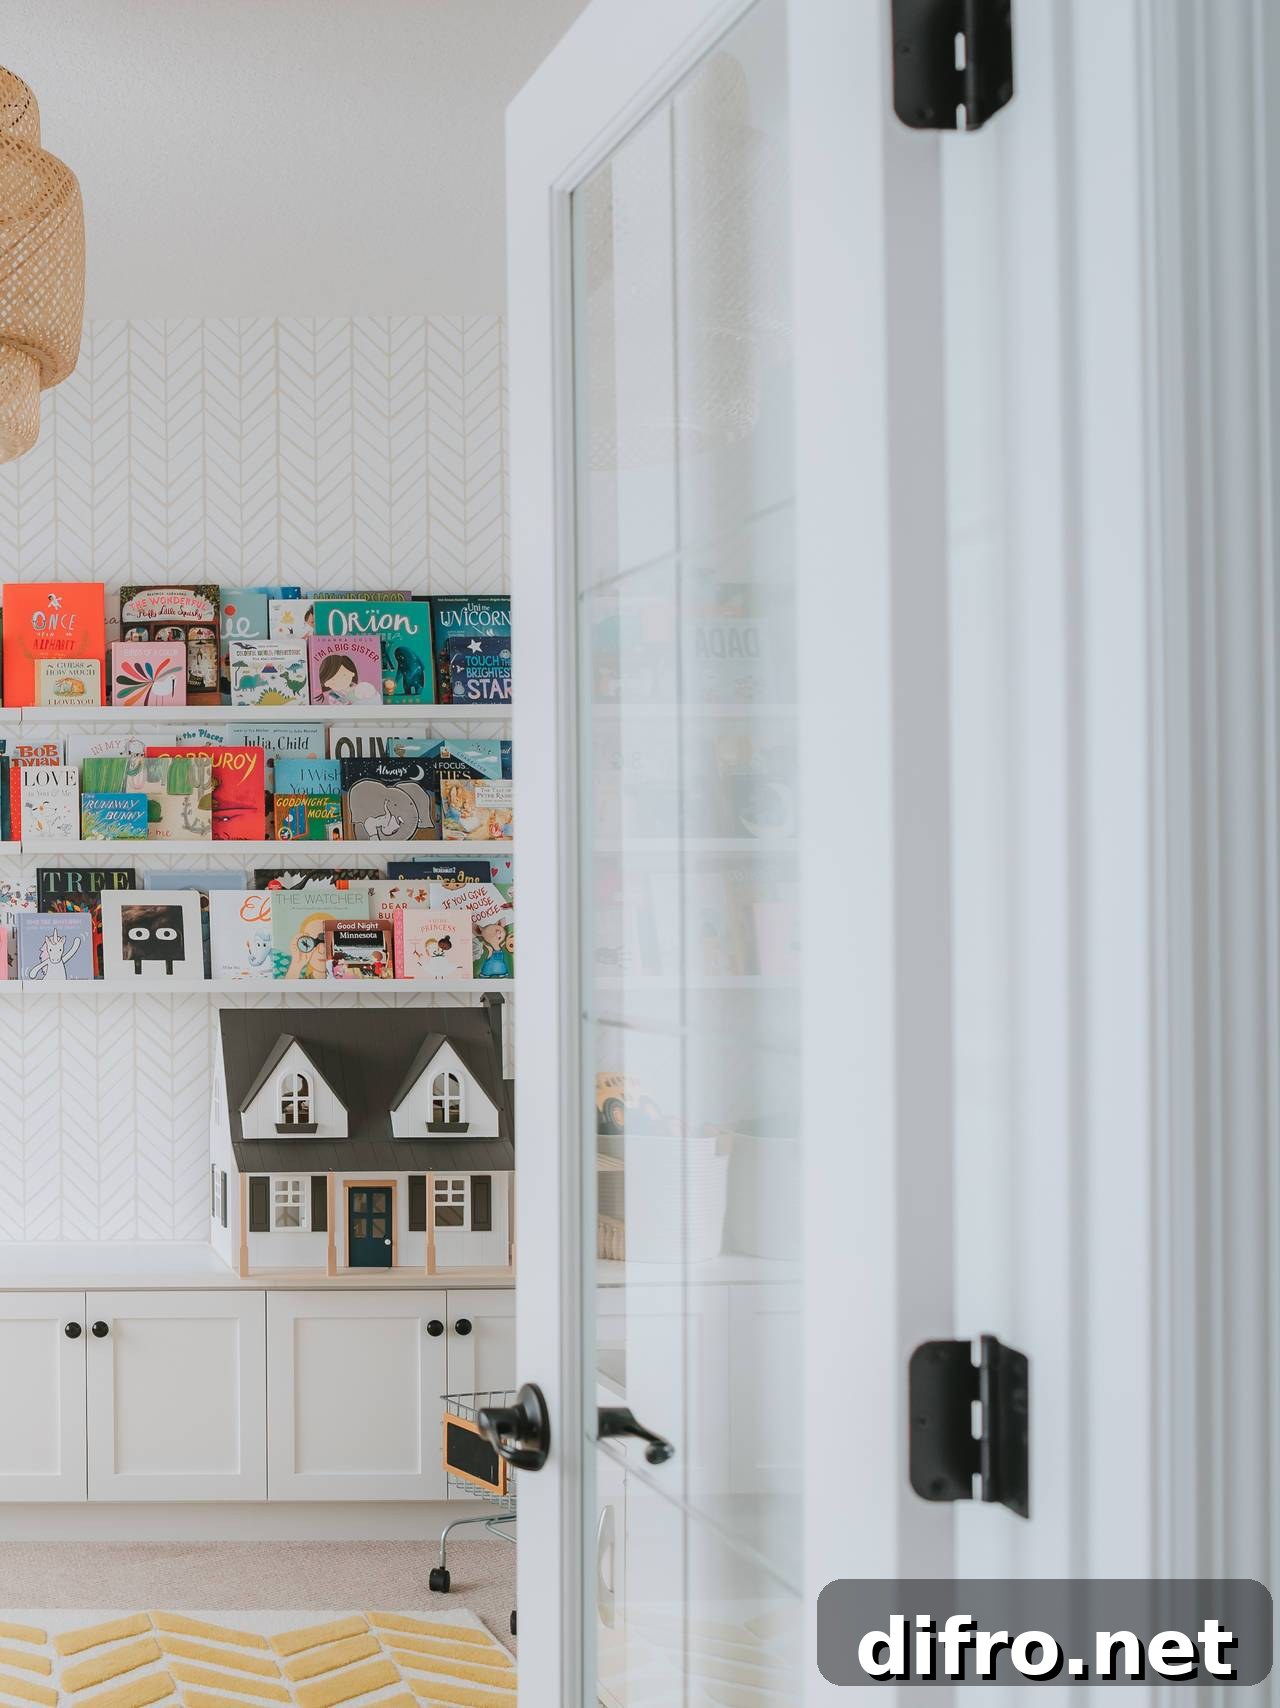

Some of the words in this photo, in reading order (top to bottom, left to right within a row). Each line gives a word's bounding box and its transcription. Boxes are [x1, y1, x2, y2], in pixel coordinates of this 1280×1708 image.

[129, 599, 147, 611] THE
[148, 596, 208, 611] WONDERFUL
[467, 603, 481, 612] Uni
[32, 610, 77, 631] ONCE
[33, 639, 77, 651] ALPHABET
[313, 649, 327, 662] I'M
[334, 643, 349, 652] BIG
[351, 643, 380, 662] SISTER
[465, 655, 500, 667] TOUCH
[466, 667, 511, 678] BRIGHTES
[182, 731, 196, 739] the
[198, 729, 224, 743] Places
[277, 736, 310, 750] Child
[335, 736, 402, 758] OLIV
[16, 744, 59, 757] BOB
[376, 764, 408, 777] Always
[439, 762, 466, 770] FOCUS
[24, 770, 77, 787] LOVE
[319, 784, 340, 794] Mo
[83, 800, 139, 810] RUNAWAY
[276, 797, 329, 807] GOODNIGHT
[104, 811, 146, 820] BUNNY
[307, 809, 337, 819] MOON
[43, 871, 130, 893] TREE
[276, 893, 300, 905] THE
[304, 893, 364, 905] WATCHER
[442, 899, 451, 911] IF
[452, 895, 467, 906] YOU
[468, 886, 488, 900] GIVE
[465, 896, 494, 912] MOUSE
[471, 905, 501, 923] COOKIE
[336, 922, 356, 930] Good
[357, 922, 379, 930] Night
[420, 923, 456, 933] PRINCESS
[339, 931, 378, 939] Minnesota
